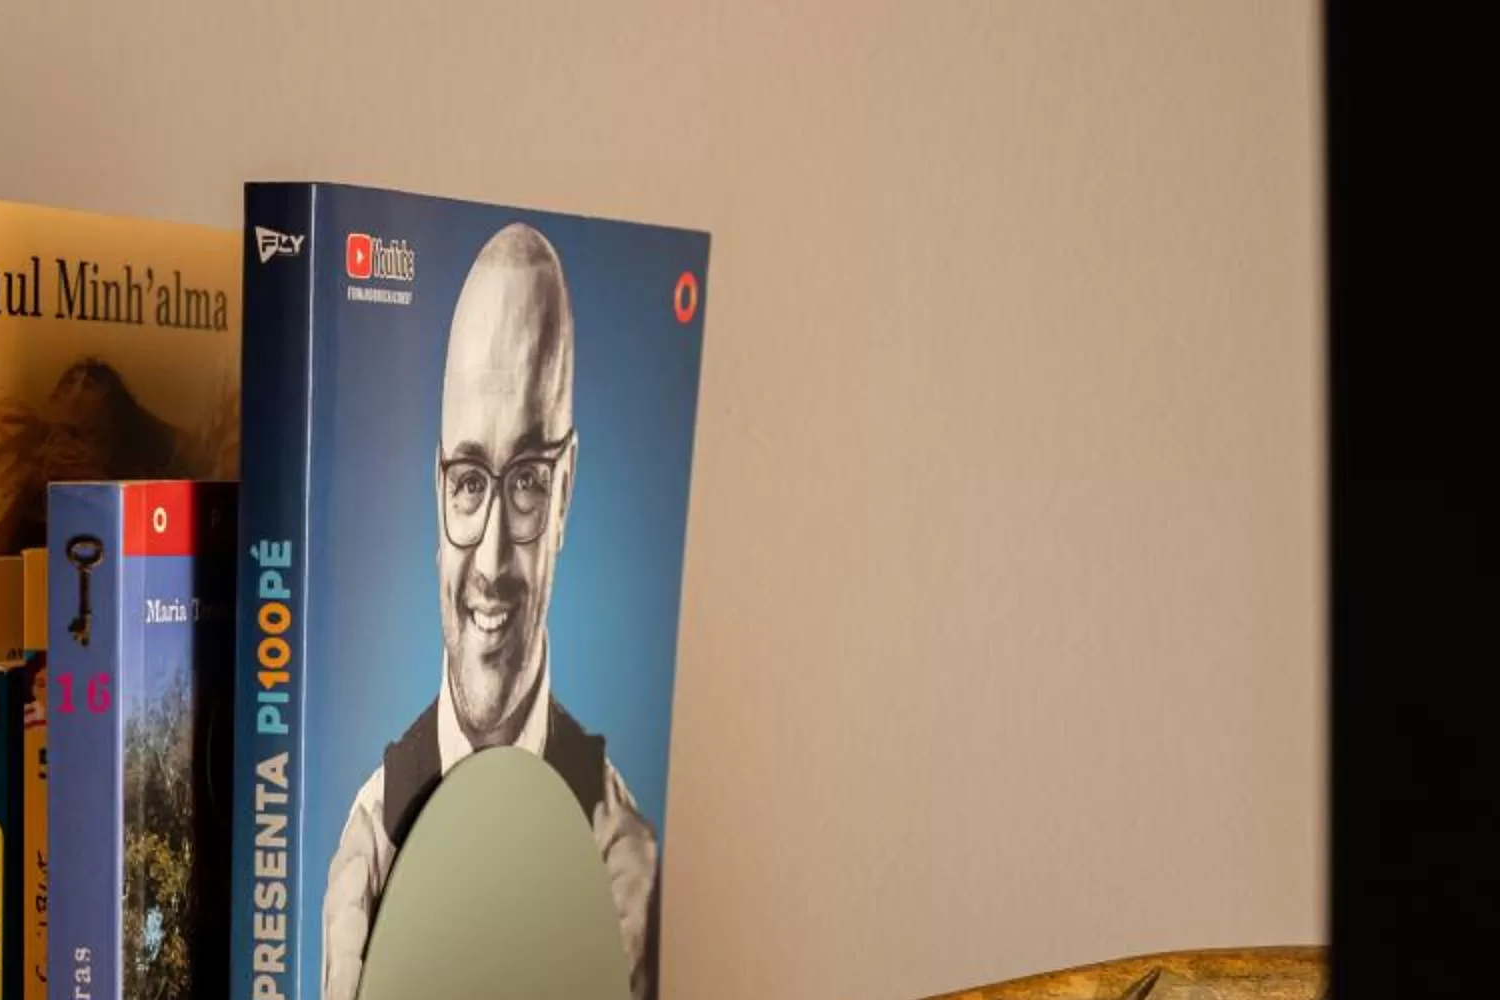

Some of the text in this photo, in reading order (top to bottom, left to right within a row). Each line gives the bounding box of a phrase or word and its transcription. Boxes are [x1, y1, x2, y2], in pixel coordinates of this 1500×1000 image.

[55, 257, 229, 332] Minh'alma
[145, 598, 187, 624] Maria
[250, 539, 293, 735] PI100PÉ
